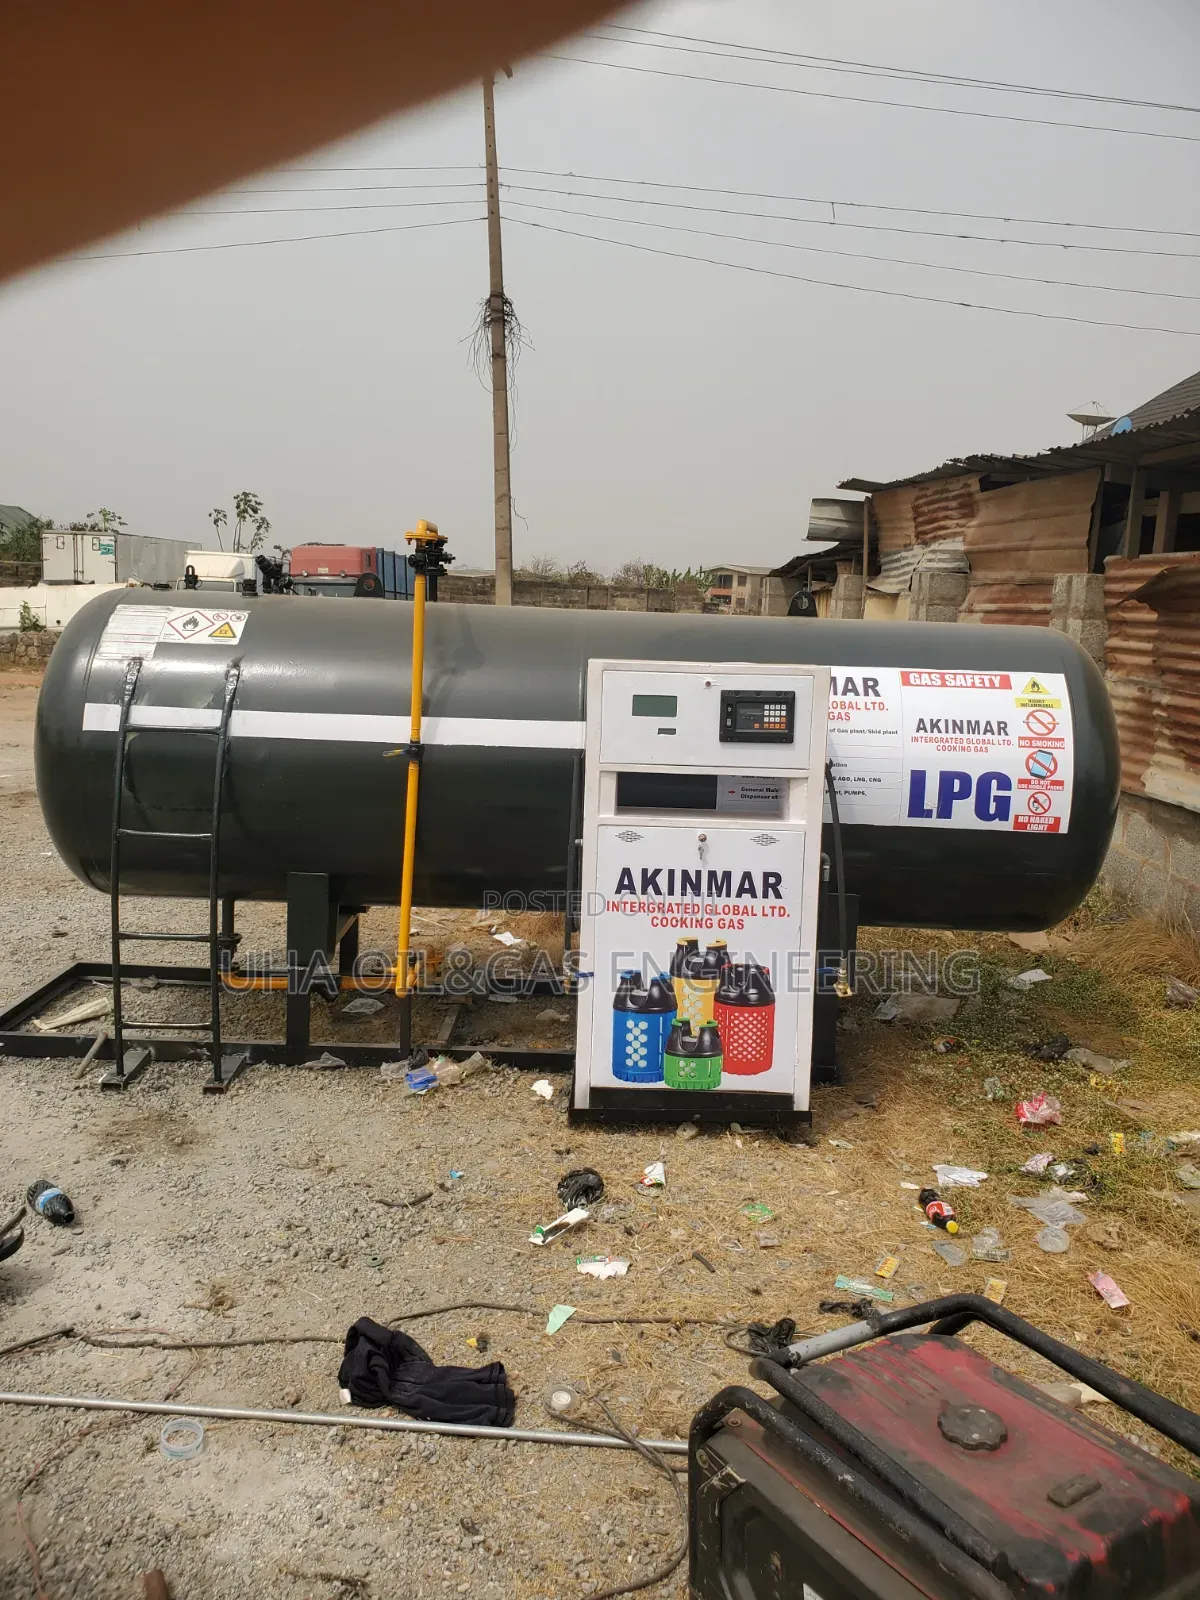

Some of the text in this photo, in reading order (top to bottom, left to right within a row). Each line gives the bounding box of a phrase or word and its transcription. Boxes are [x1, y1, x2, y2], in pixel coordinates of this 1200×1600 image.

[909, 672, 1001, 688] GAS SAFETY
[864, 701, 889, 712] LTD.
[828, 711, 851, 721] GAS
[916, 717, 1009, 737] AKINMAR
[911, 735, 1014, 747] INTERGRATED GLOBAL LTD.
[1019, 739, 1065, 749] NO SMOKING
[936, 744, 989, 754] COOKING GAS
[908, 770, 1012, 822] LPG
[1018, 815, 1055, 825] NO NAKED
[614, 867, 783, 900] AKINMAR
[606, 899, 791, 919] INTERGRATED GLOBAL LTD.
[650, 915, 745, 931] COOKING GAS
